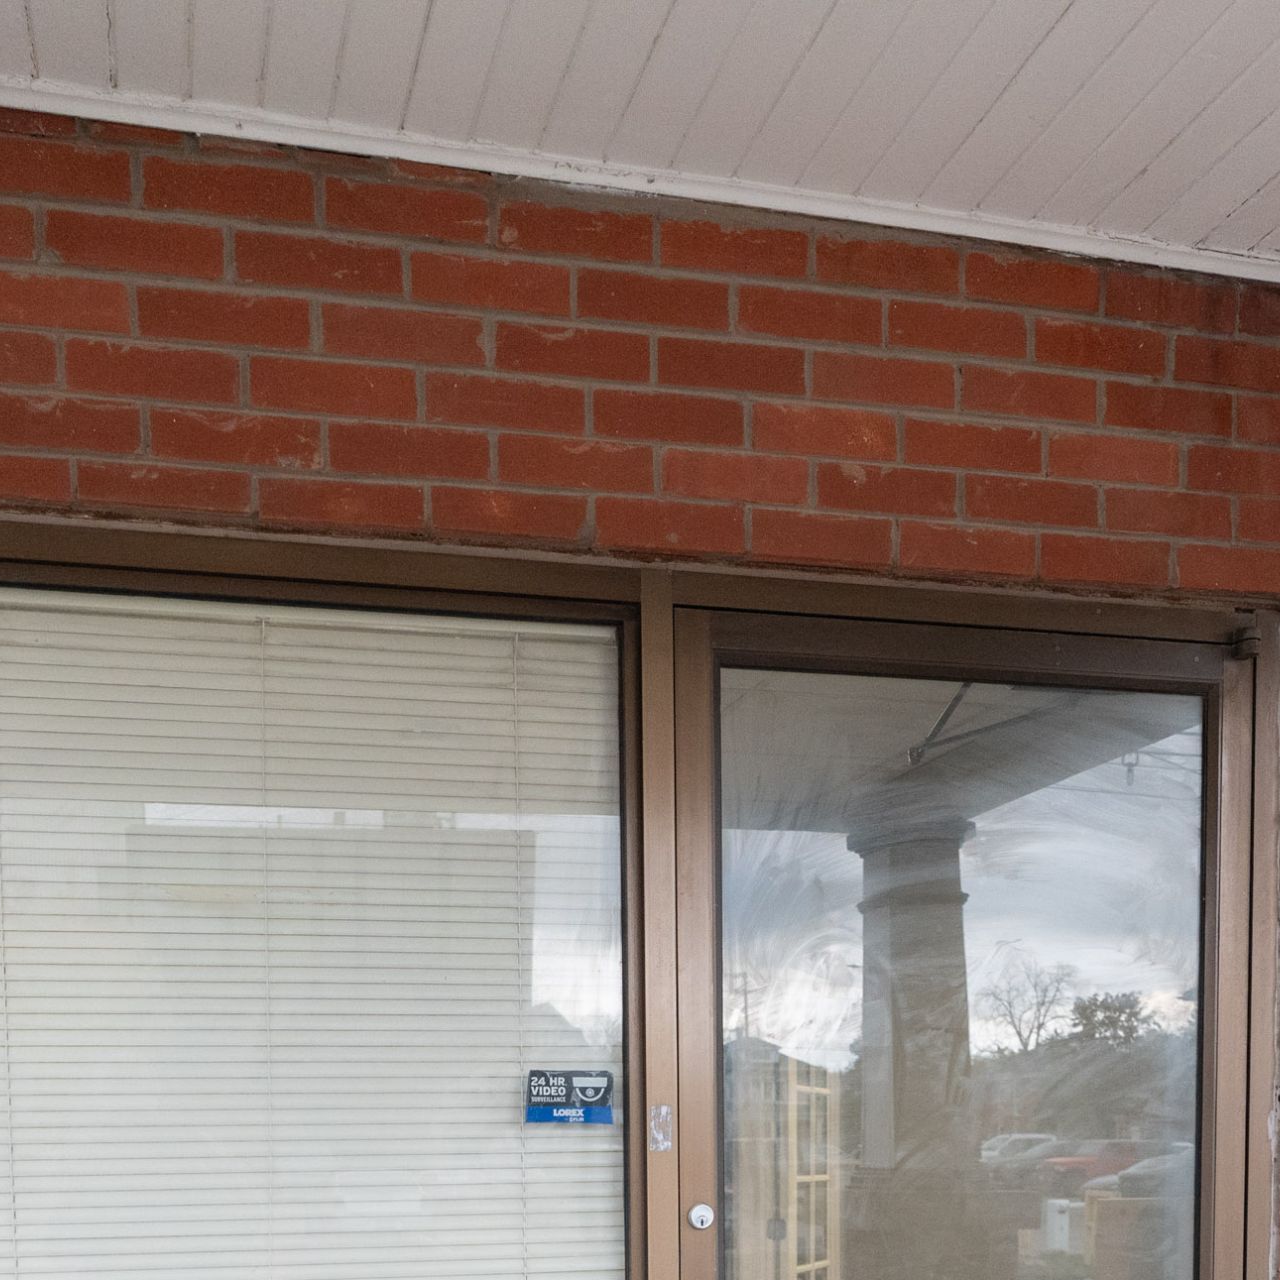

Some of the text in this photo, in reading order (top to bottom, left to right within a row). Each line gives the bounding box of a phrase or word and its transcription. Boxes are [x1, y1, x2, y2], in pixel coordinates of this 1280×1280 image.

[531, 1077, 546, 1087] 24
[531, 1086, 566, 1096] VIDEO
[553, 1108, 584, 1117] LOREX
